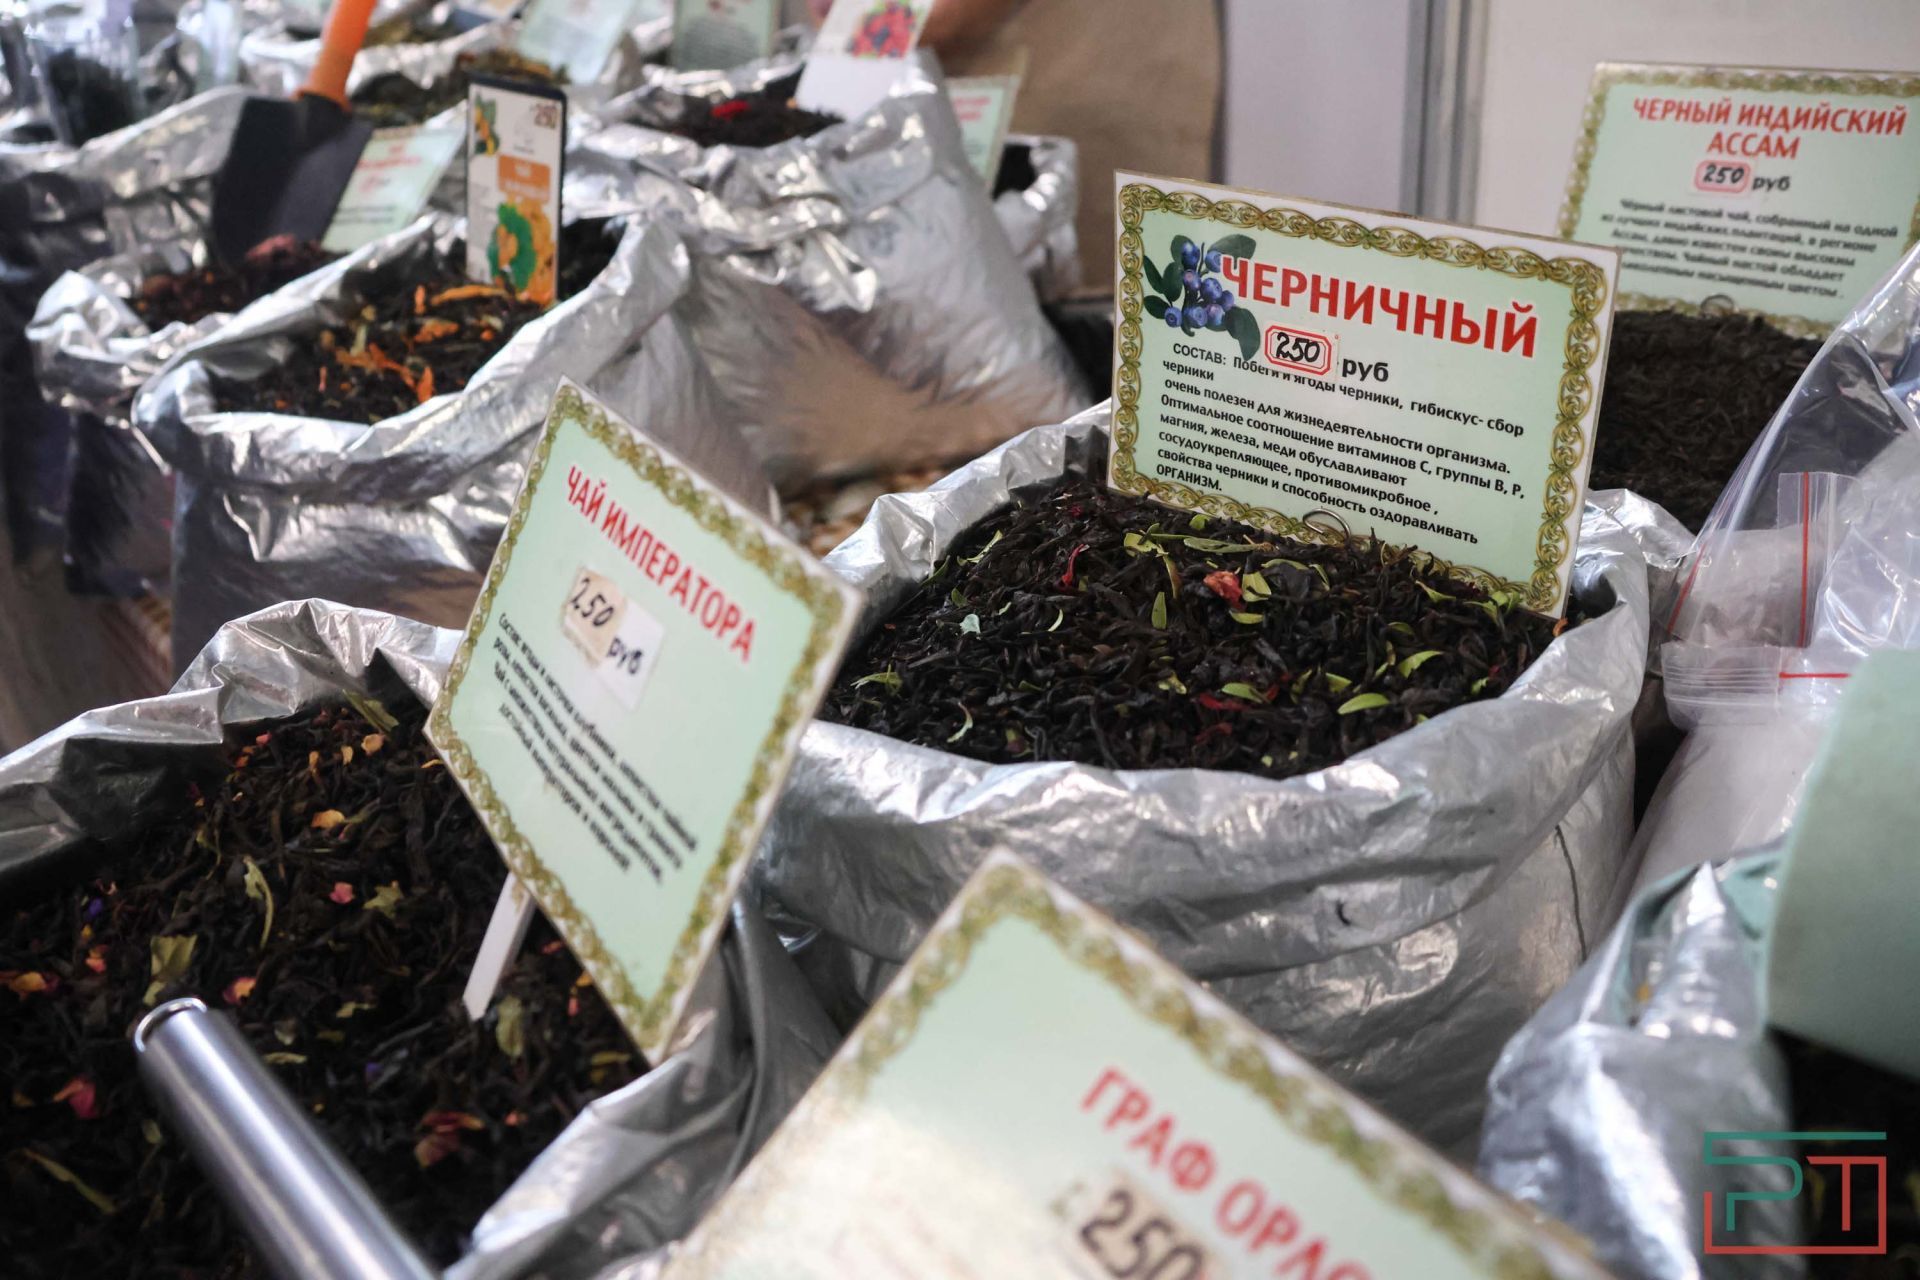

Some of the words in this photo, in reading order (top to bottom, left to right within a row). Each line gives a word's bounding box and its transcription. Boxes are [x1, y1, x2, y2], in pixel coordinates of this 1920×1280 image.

[1633, 97, 1732, 125] ЧЕРНЫЙ
[1737, 102, 1908, 136] ИНДИЙСКИЙ
[1707, 131, 1801, 160] АССАМ
[1703, 164, 1745, 184] 250
[1752, 173, 1791, 191] руб
[1220, 255, 1539, 358] ЧЕРНИЧНЫЙ
[1163, 361, 1214, 381] черники
[1173, 343, 1226, 365] СОСТАВ:
[1283, 373, 1291, 381] и
[1339, 385, 1403, 409] черники,
[1411, 402, 1483, 425] гибискус-
[1487, 419, 1524, 437] сбор
[1275, 332, 1321, 363] 250
[1342, 358, 1389, 382] руб
[1159, 432, 1291, 476] сосудоукрепляющее,
[1295, 468, 1431, 511] противомикробное
[1161, 394, 1243, 425] Оптимальное
[1247, 418, 1334, 450] соотношение
[1337, 443, 1416, 469] витаминов
[1436, 467, 1490, 488] группы
[1161, 414, 1207, 435] магния,
[1211, 427, 1259, 448] железа,
[1263, 441, 1296, 458] меди
[1299, 451, 1407, 486] обуславливают
[1165, 379, 1201, 395] очень
[1204, 389, 1254, 409] полезен
[1257, 403, 1280, 416] для
[1284, 409, 1422, 452] жизнедеятельности
[1426, 445, 1510, 473] организма.
[1157, 464, 1222, 491] ОРГАНИЗМ.
[1158, 449, 1212, 471] свойства
[1216, 464, 1268, 486] черники
[1272, 480, 1279, 489] и
[1282, 483, 1366, 513] способность
[1370, 507, 1477, 544] оздоравливать
[567, 464, 607, 524] ЧАЙ
[602, 503, 756, 664] ИМПЕРАТОРА
[570, 577, 614, 627] 250
[607, 637, 643, 675] руб
[1081, 1064, 1217, 1192] ГРАФ
[1080, 1188, 1204, 1280] 250
